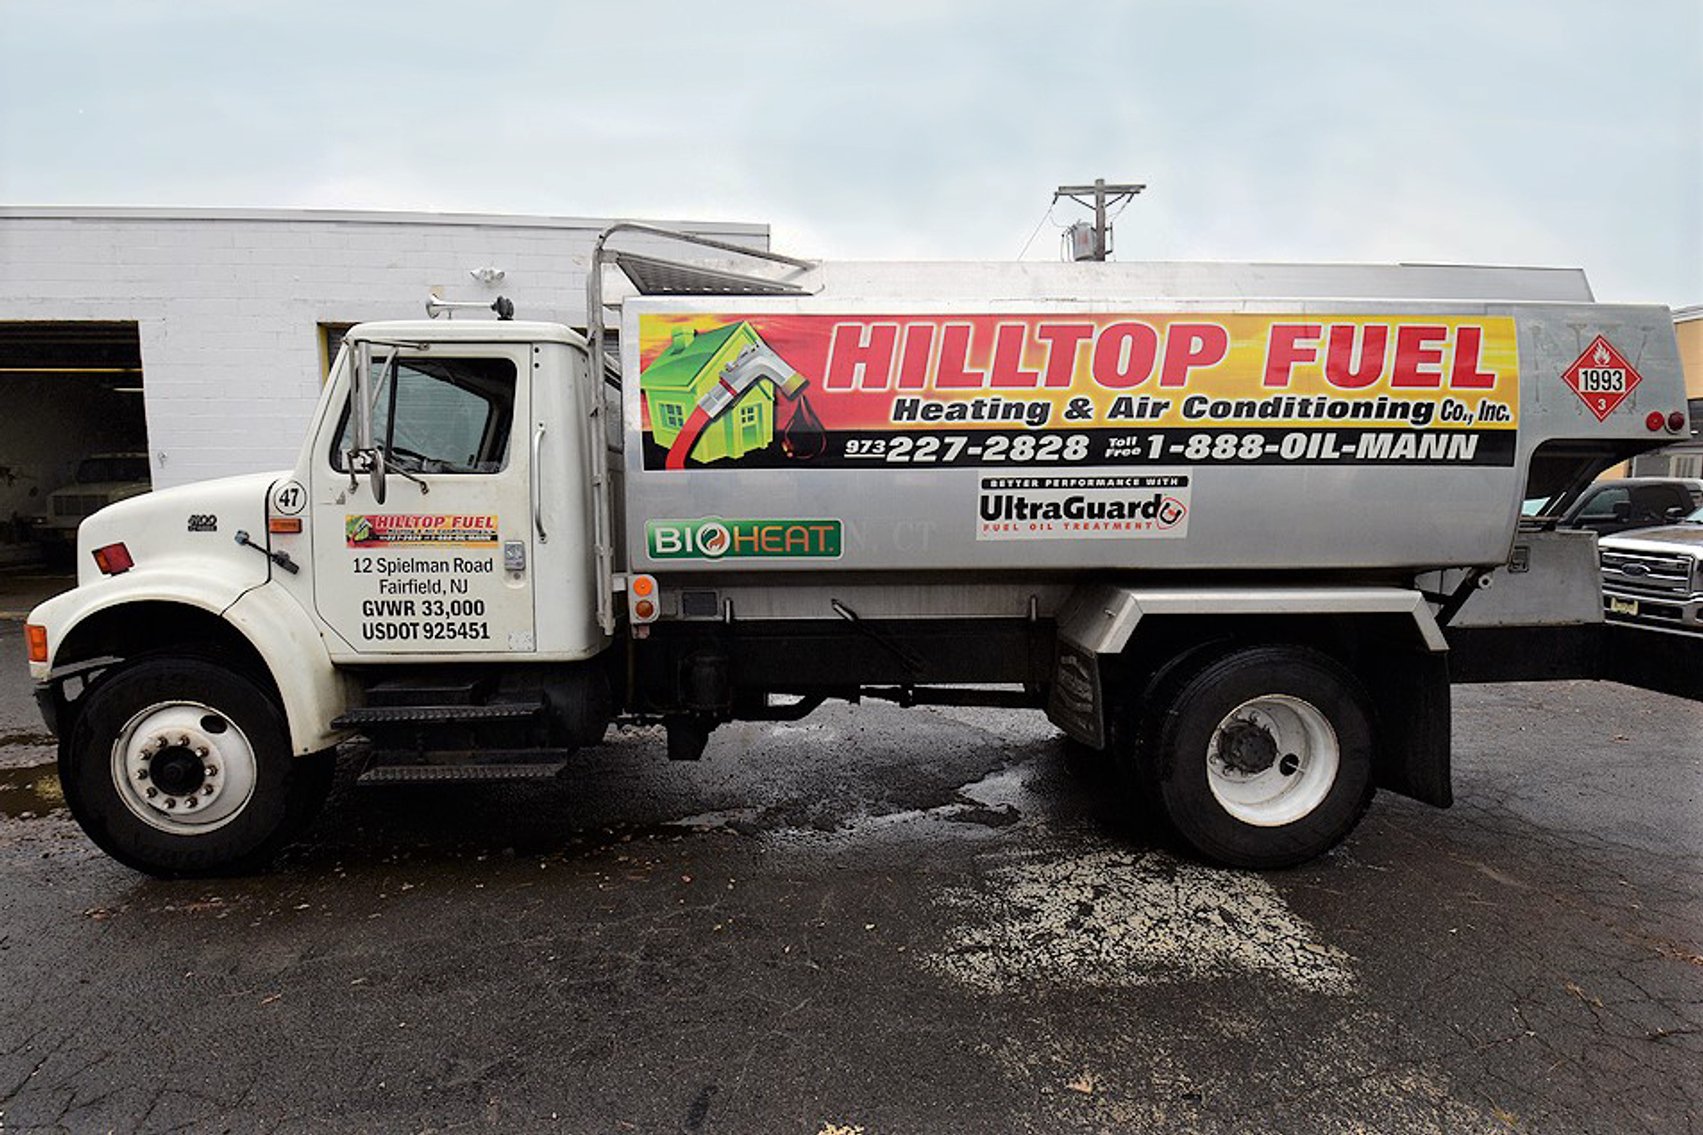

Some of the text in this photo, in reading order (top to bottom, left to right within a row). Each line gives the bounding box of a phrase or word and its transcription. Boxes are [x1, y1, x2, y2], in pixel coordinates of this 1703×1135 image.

[824, 321, 1228, 393] HILLTOP
[1262, 321, 1498, 391] FUEL
[1582, 369, 1624, 392] 1993
[892, 397, 1511, 426] Heating & Air Conditioning Co., Inc.
[1598, 398, 1607, 411] 3
[845, 434, 1090, 463] 973 227-2828
[1108, 436, 1138, 447] Toll
[1147, 434, 1478, 460] 1-888-OIL-MANN
[1105, 447, 1141, 458] Free
[990, 478, 1179, 488] BETTER PERFORMANCE WITH
[279, 488, 299, 507] 47
[980, 494, 1163, 521] UltraGuard
[377, 516, 493, 528] HILLTOP FUEL
[983, 522, 1152, 532] FUEL OIL TREATMENT
[353, 557, 493, 576] 12 Spielman Road
[380, 578, 469, 596] Fairfield, NJ
[362, 600, 485, 619] GVWR 33,000
[362, 621, 490, 640] USDOT 925451
